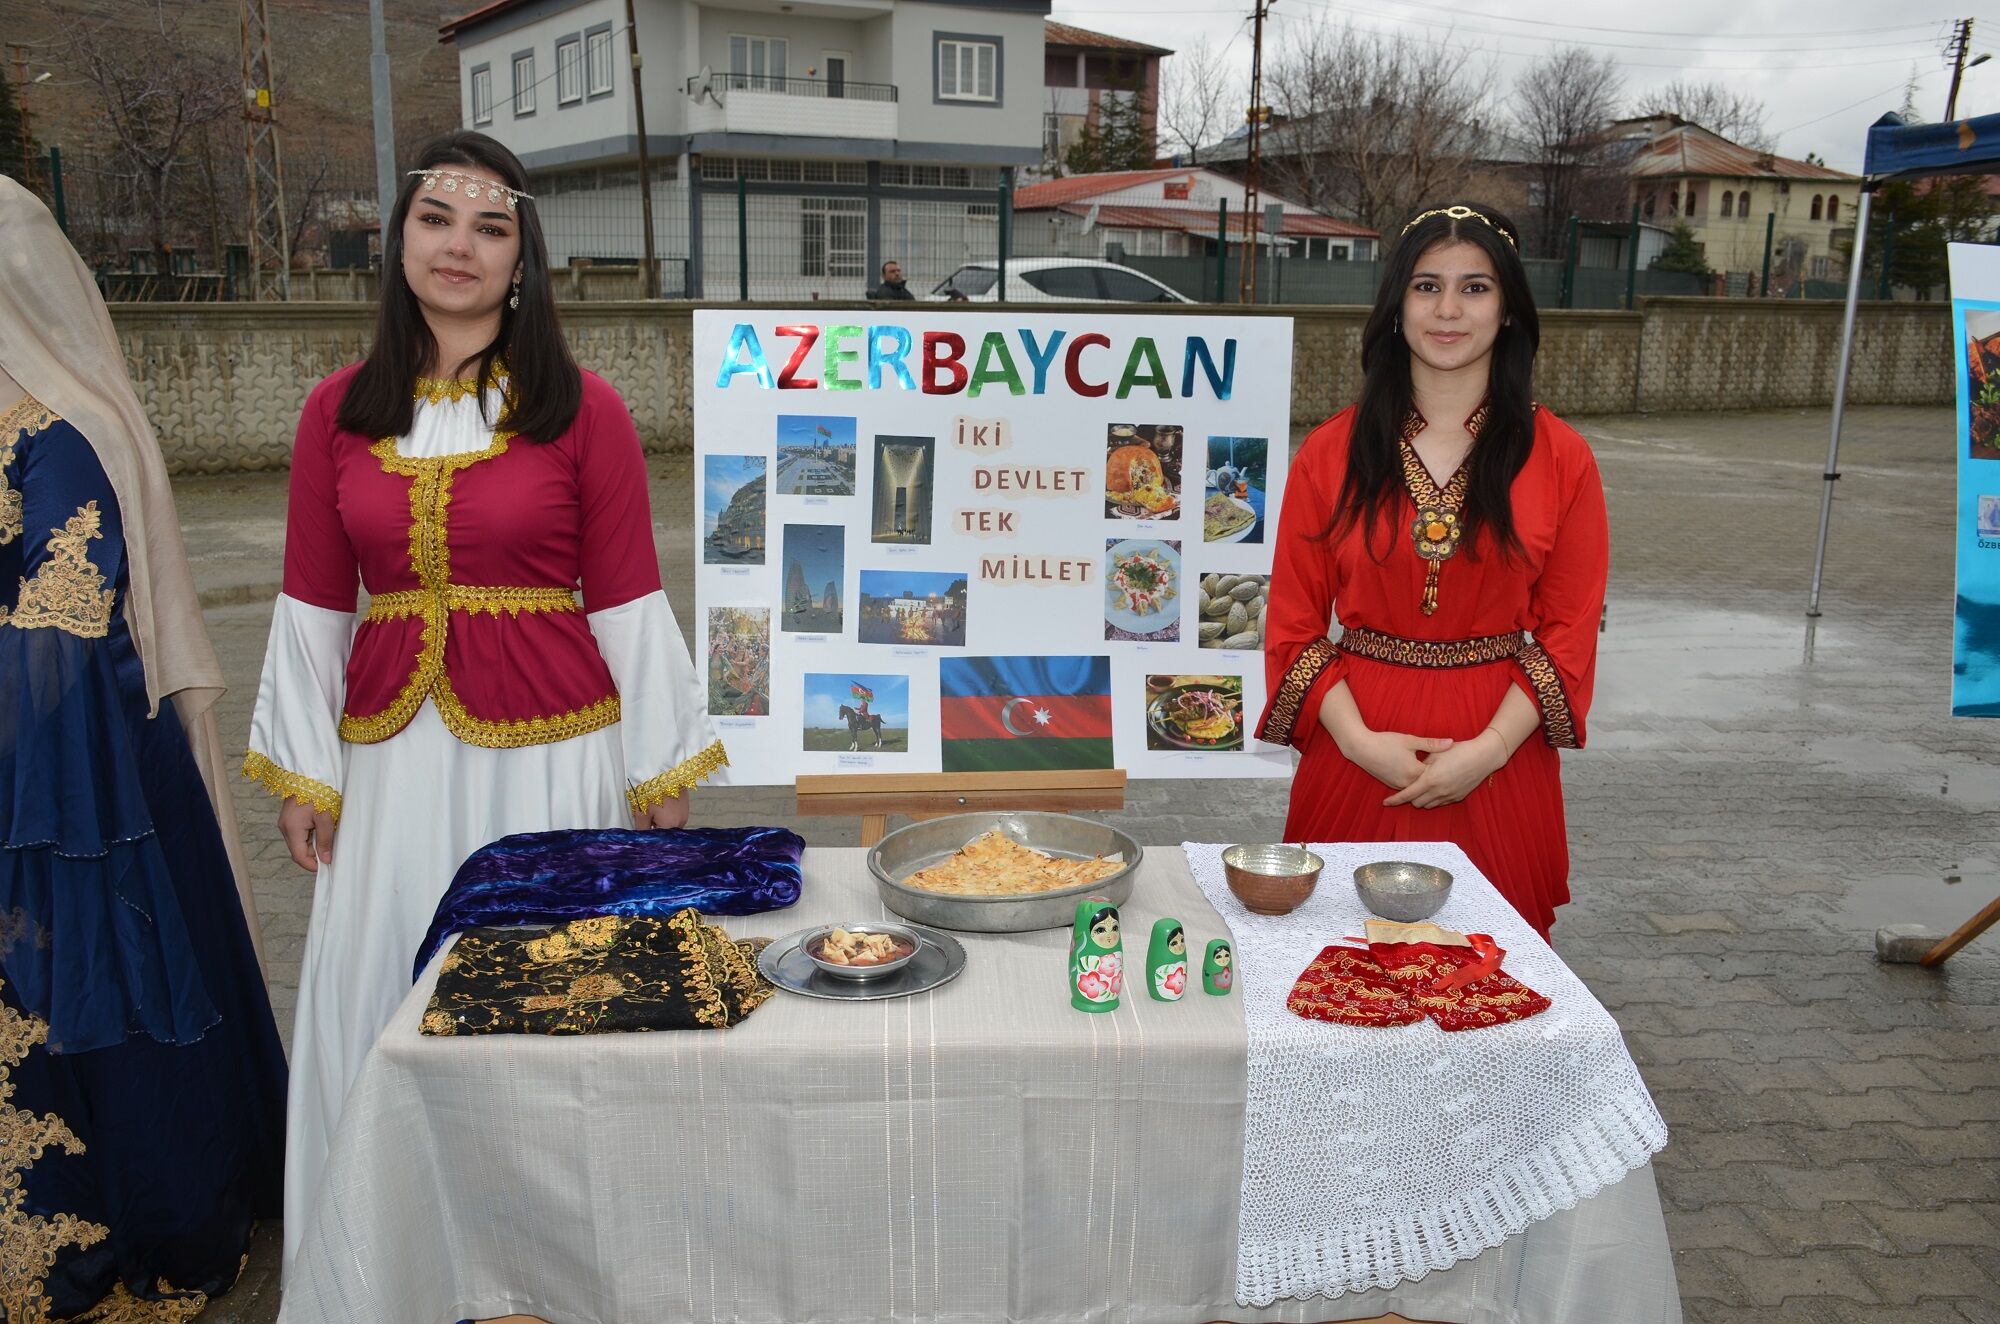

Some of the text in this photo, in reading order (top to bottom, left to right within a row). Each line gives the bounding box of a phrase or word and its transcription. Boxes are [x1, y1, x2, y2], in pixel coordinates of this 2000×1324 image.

[716, 323, 1236, 399] AZERBAYCAN
[958, 418, 1001, 446] İKİ
[975, 470, 1085, 491] DEVLET
[961, 512, 1014, 532] TEK
[981, 554, 1091, 582] MİLLET
